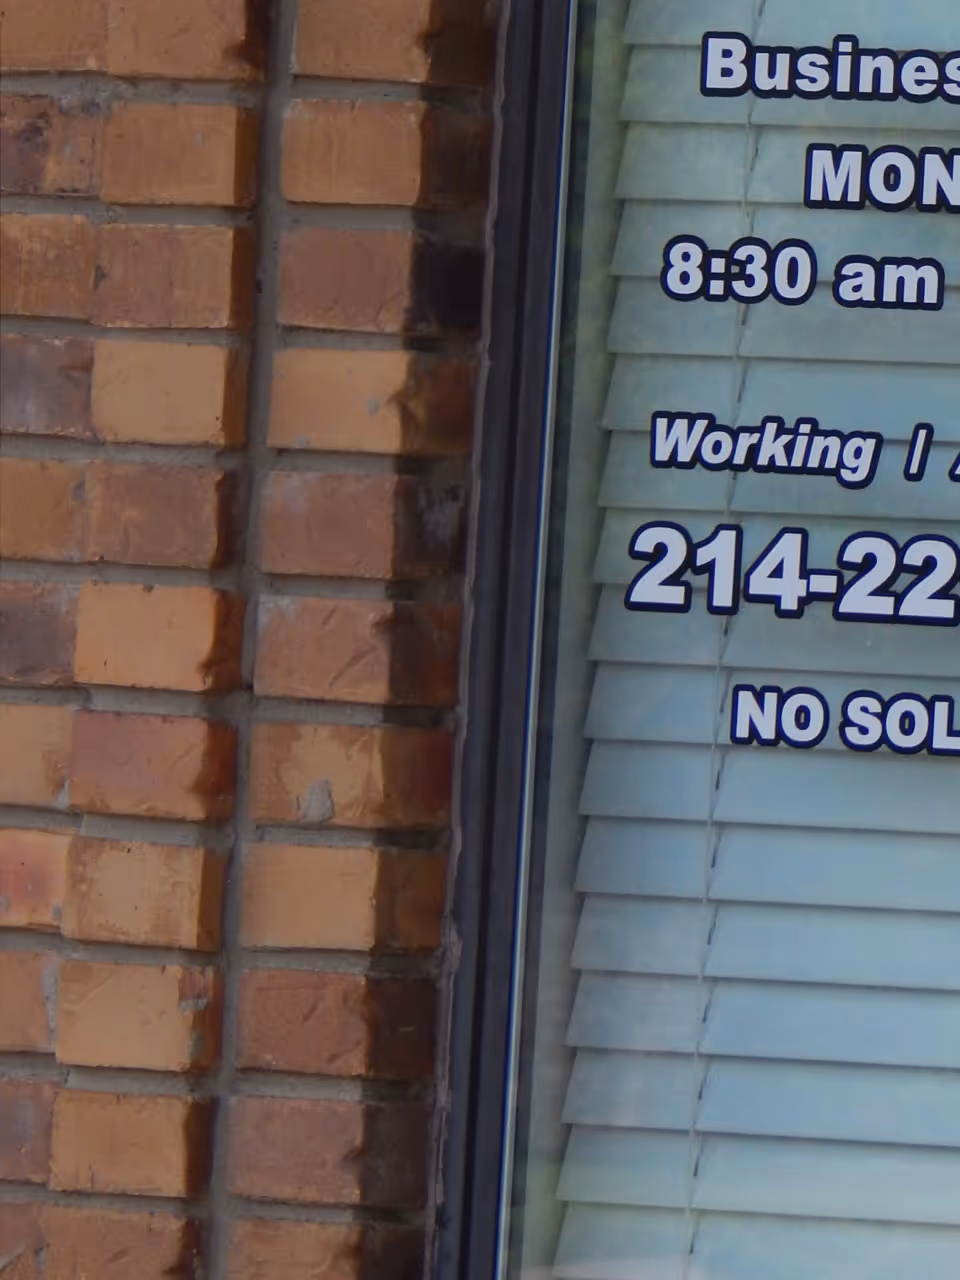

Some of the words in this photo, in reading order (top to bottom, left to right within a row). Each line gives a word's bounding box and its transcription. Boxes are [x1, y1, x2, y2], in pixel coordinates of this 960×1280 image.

[662, 236, 816, 303] 8:30
[834, 255, 944, 309] am
[652, 413, 881, 488] Working
[733, 684, 828, 747] NO
